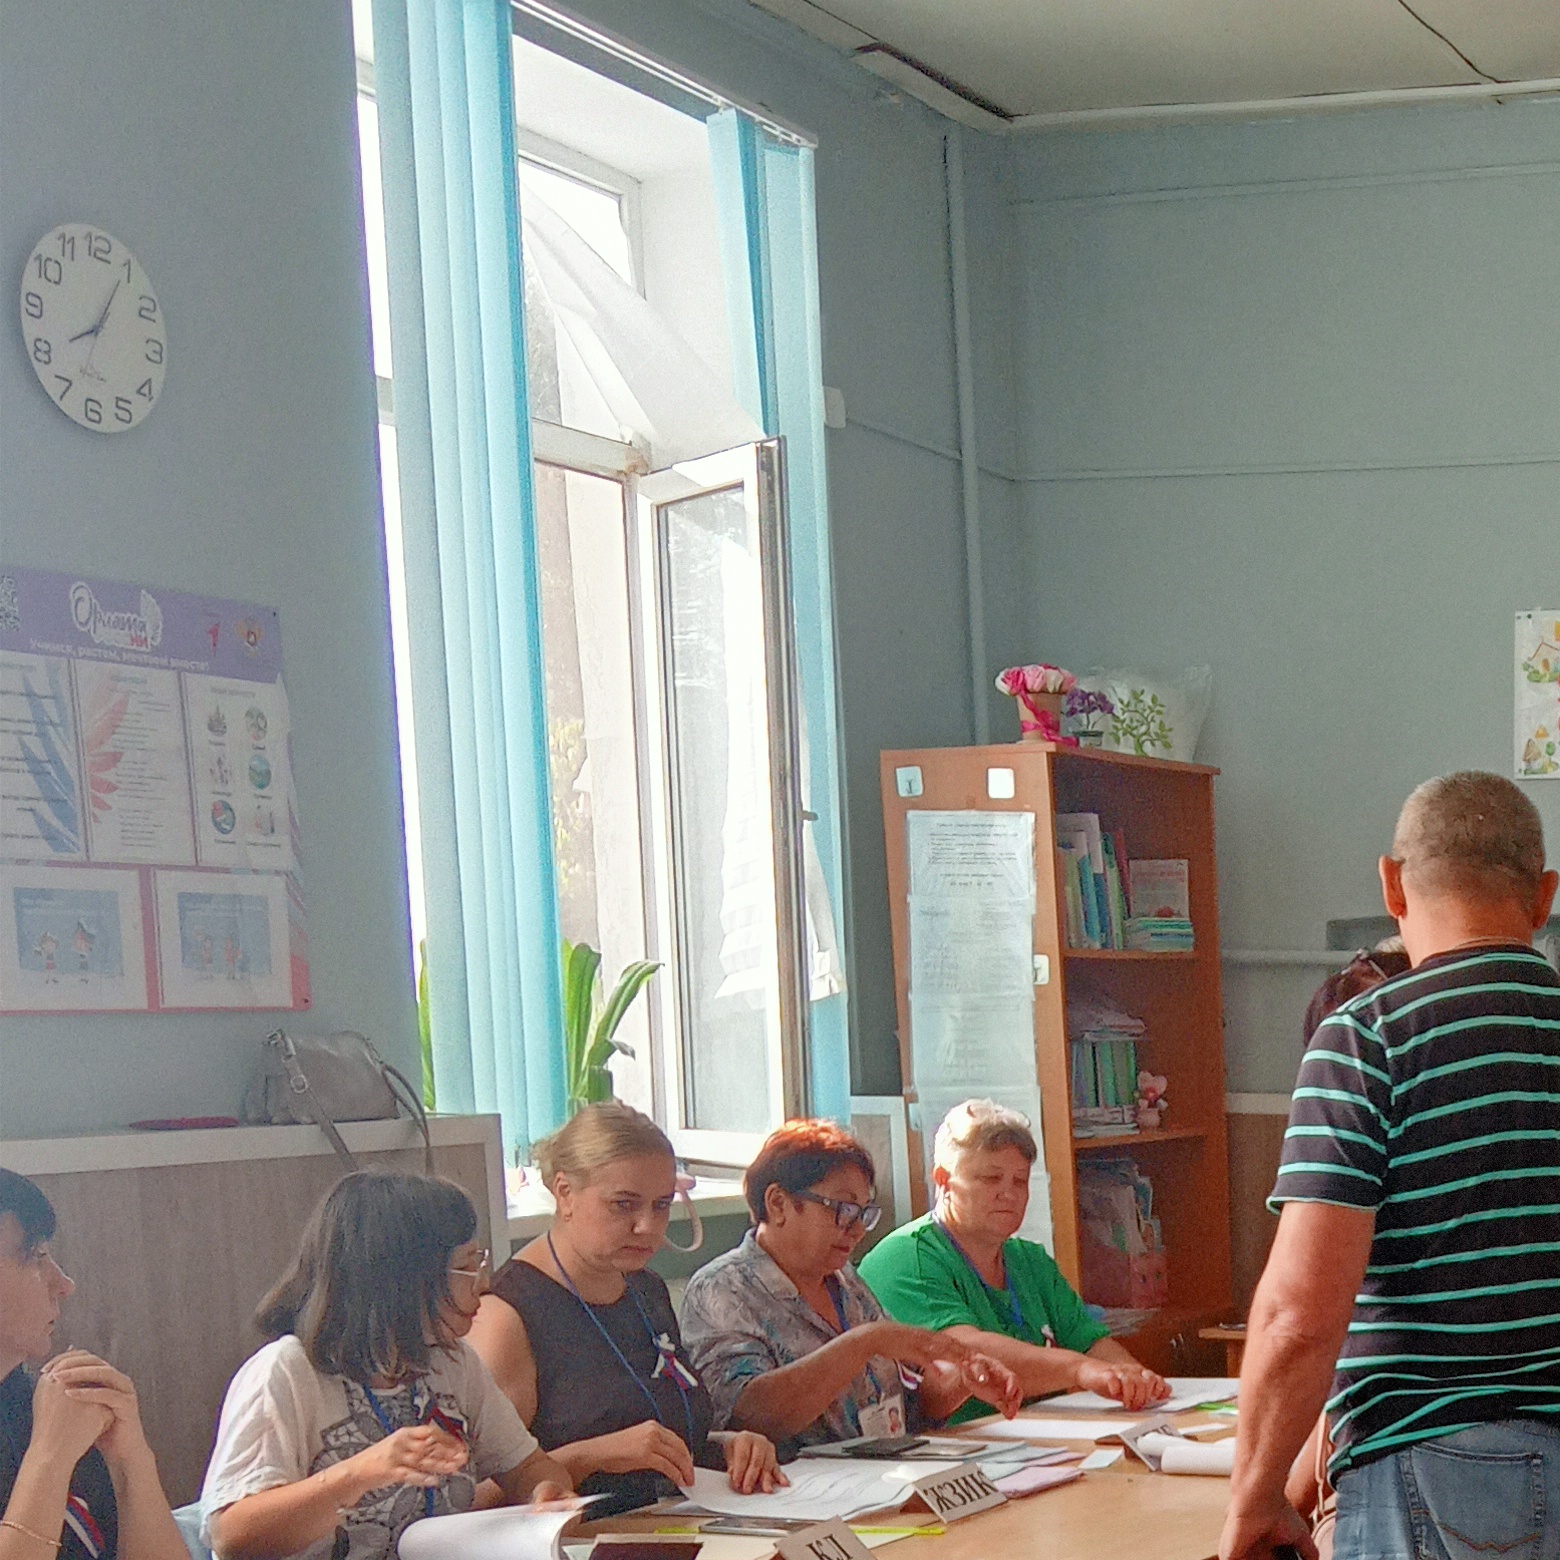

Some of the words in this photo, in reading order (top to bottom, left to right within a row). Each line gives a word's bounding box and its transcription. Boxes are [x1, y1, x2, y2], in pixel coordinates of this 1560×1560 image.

[58, 232, 75, 261] 11
[84, 231, 112, 265] 12
[34, 253, 62, 285] 10
[123, 259, 131, 283] 1
[25, 292, 43, 319] 9
[138, 295, 157, 323] 2
[33, 338, 51, 365] 8
[145, 338, 164, 365] 3
[54, 374, 72, 400] 7
[136, 378, 153, 402] 4
[85, 398, 102, 424] 6
[115, 397, 132, 424] 5
[923, 1470, 999, 1513] ЖЗИК
